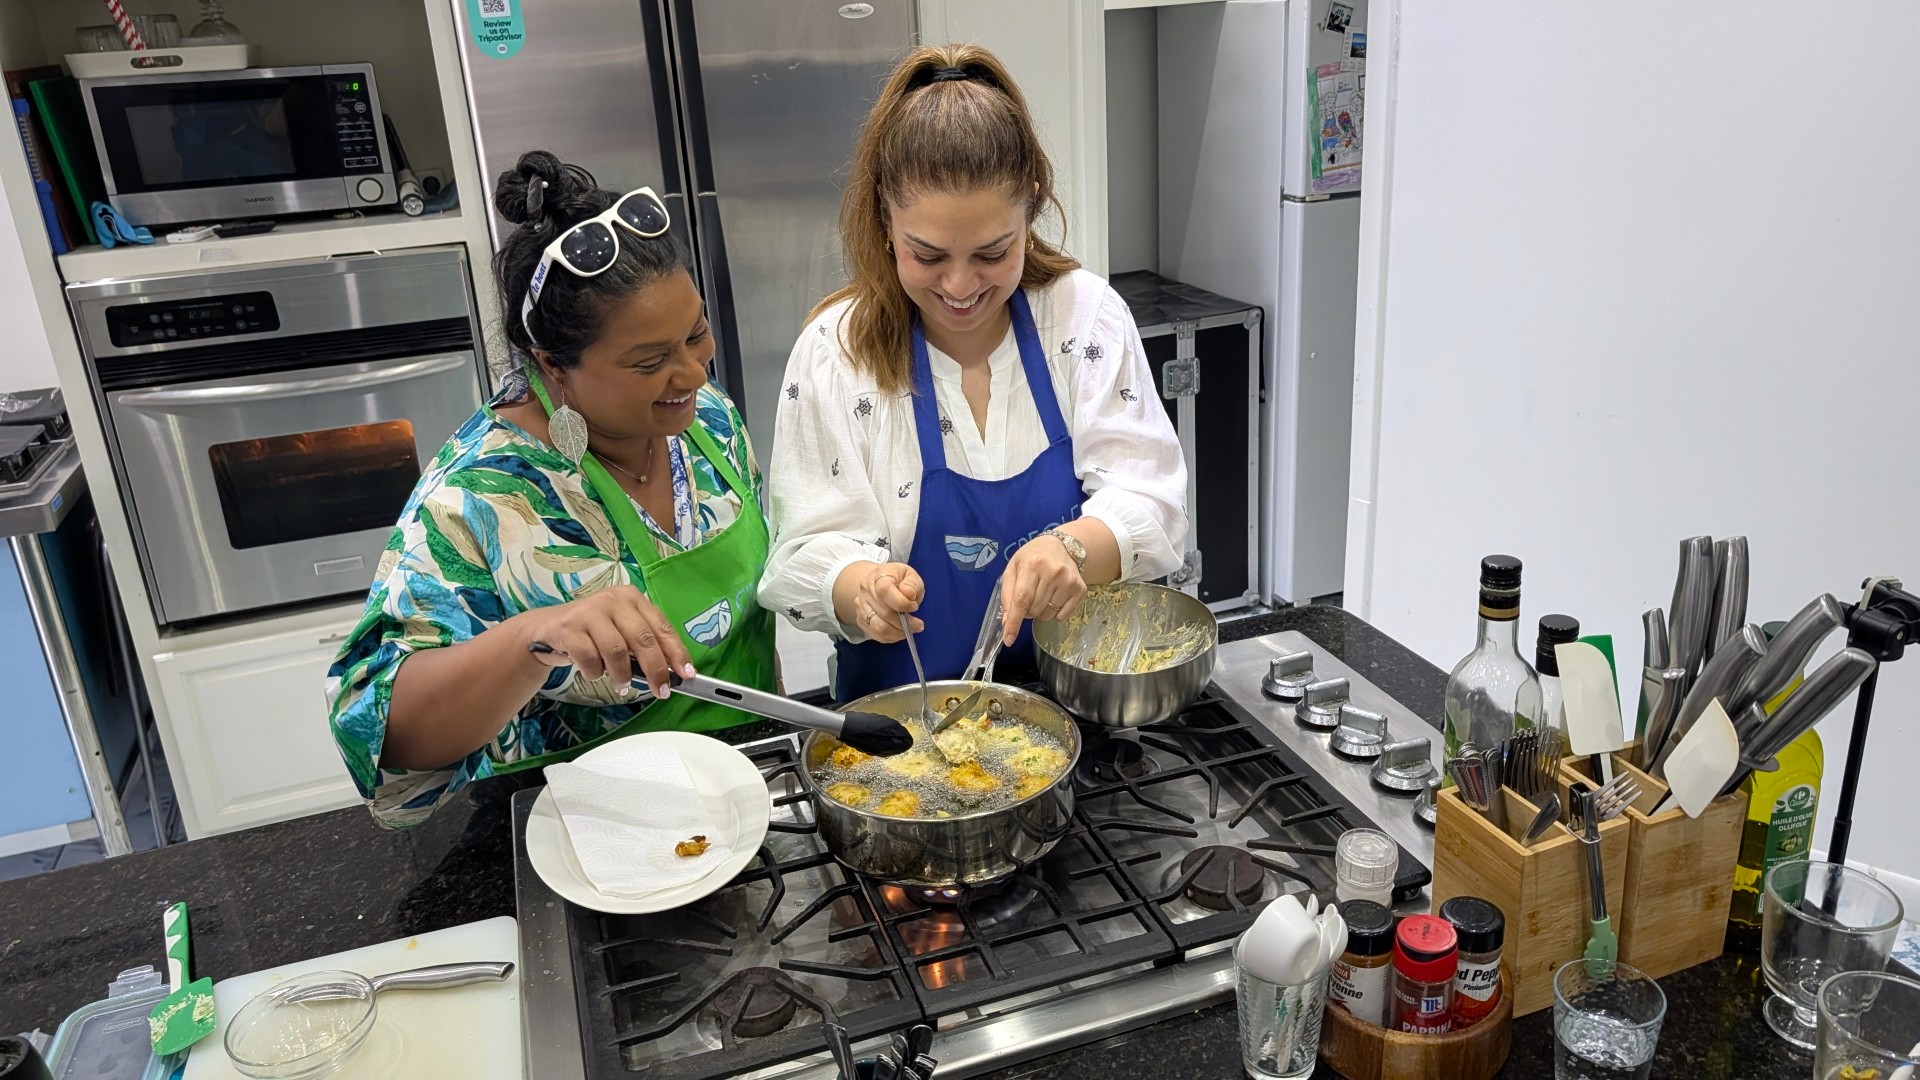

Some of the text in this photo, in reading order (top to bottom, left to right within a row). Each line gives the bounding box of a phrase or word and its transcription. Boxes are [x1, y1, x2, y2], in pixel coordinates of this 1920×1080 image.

[483, 20, 511, 28] Review
[478, 34, 522, 43] Tripadvisor
[531, 262, 547, 294] le boat
[1772, 817, 1792, 826] HUILE
